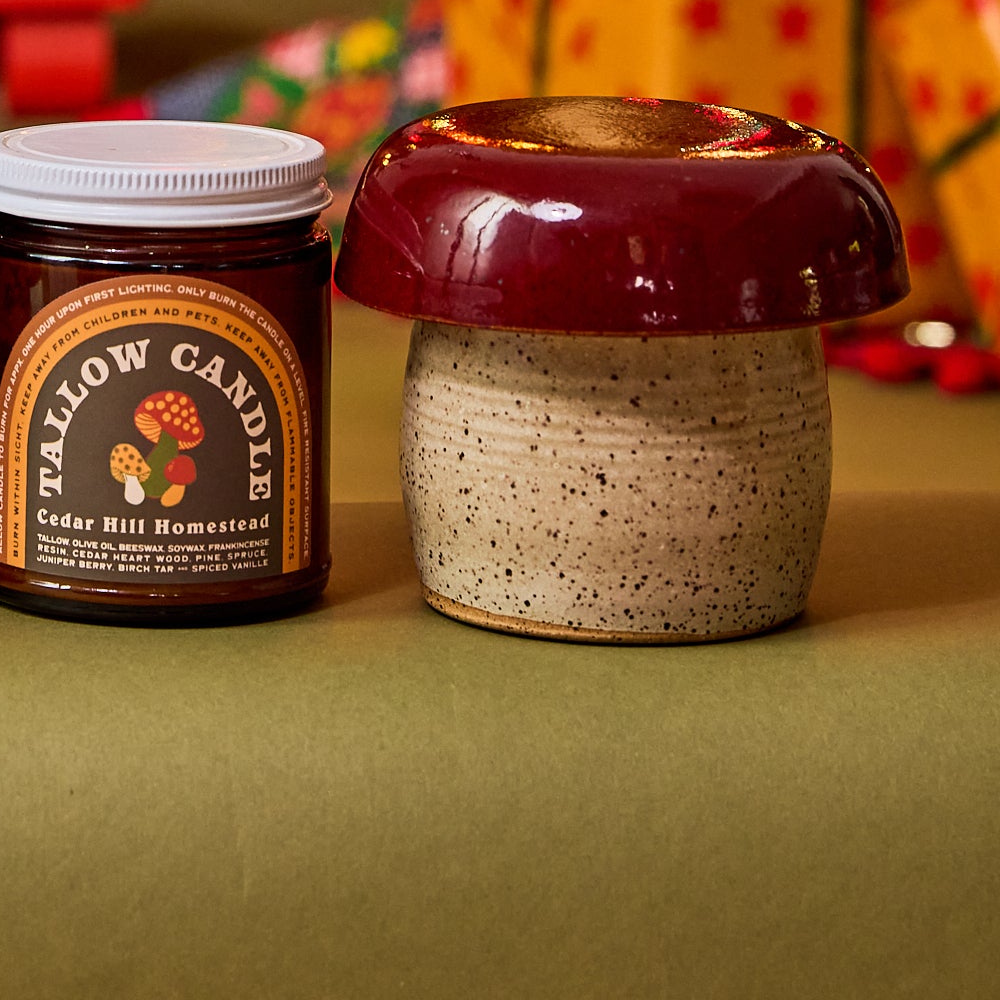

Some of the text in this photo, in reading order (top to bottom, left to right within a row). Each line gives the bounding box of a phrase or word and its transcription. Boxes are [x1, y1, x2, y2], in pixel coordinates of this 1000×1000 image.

[83, 288, 115, 305] FIRST
[177, 285, 206, 297] ONLY
[208, 291, 237, 308] BURN
[56, 299, 83, 319] UPON
[239, 302, 257, 320] THE
[34, 315, 56, 339] HOUR
[256, 316, 285, 348] CANDLE
[21, 336, 36, 357] ONE
[283, 348, 293, 362] ON
[290, 363, 296, 371] A
[3, 386, 13, 409] FOR
[20, 383, 32, 416] KEEP
[32, 352, 51, 380] AWAY
[52, 328, 80, 352] FROM
[83, 307, 147, 330] CHILDREN
[154, 307, 180, 316] AND
[225, 323, 253, 344] KEEP
[254, 346, 275, 370] AWAY
[274, 373, 289, 406] FROM
[286, 411, 295, 492] FLAMMABLE
[0, 411, 8, 442] BURN
[39, 338, 272, 501] TALLOW CANDLE
[0, 445, 4, 459] TO
[36, 507, 269, 535] Cedar Hill Homestead
[72, 539, 99, 549] OLIVE
[208, 538, 270, 551] FRANKINCENSE
[37, 554, 76, 567] JUNIPER
[118, 564, 150, 573] BIRCH
[154, 565, 174, 573] TAR
[192, 563, 229, 573] SPICED
[231, 559, 268, 570] VANILLE
[72, 549, 109, 560] CEDAR
[113, 554, 151, 562] HEART
